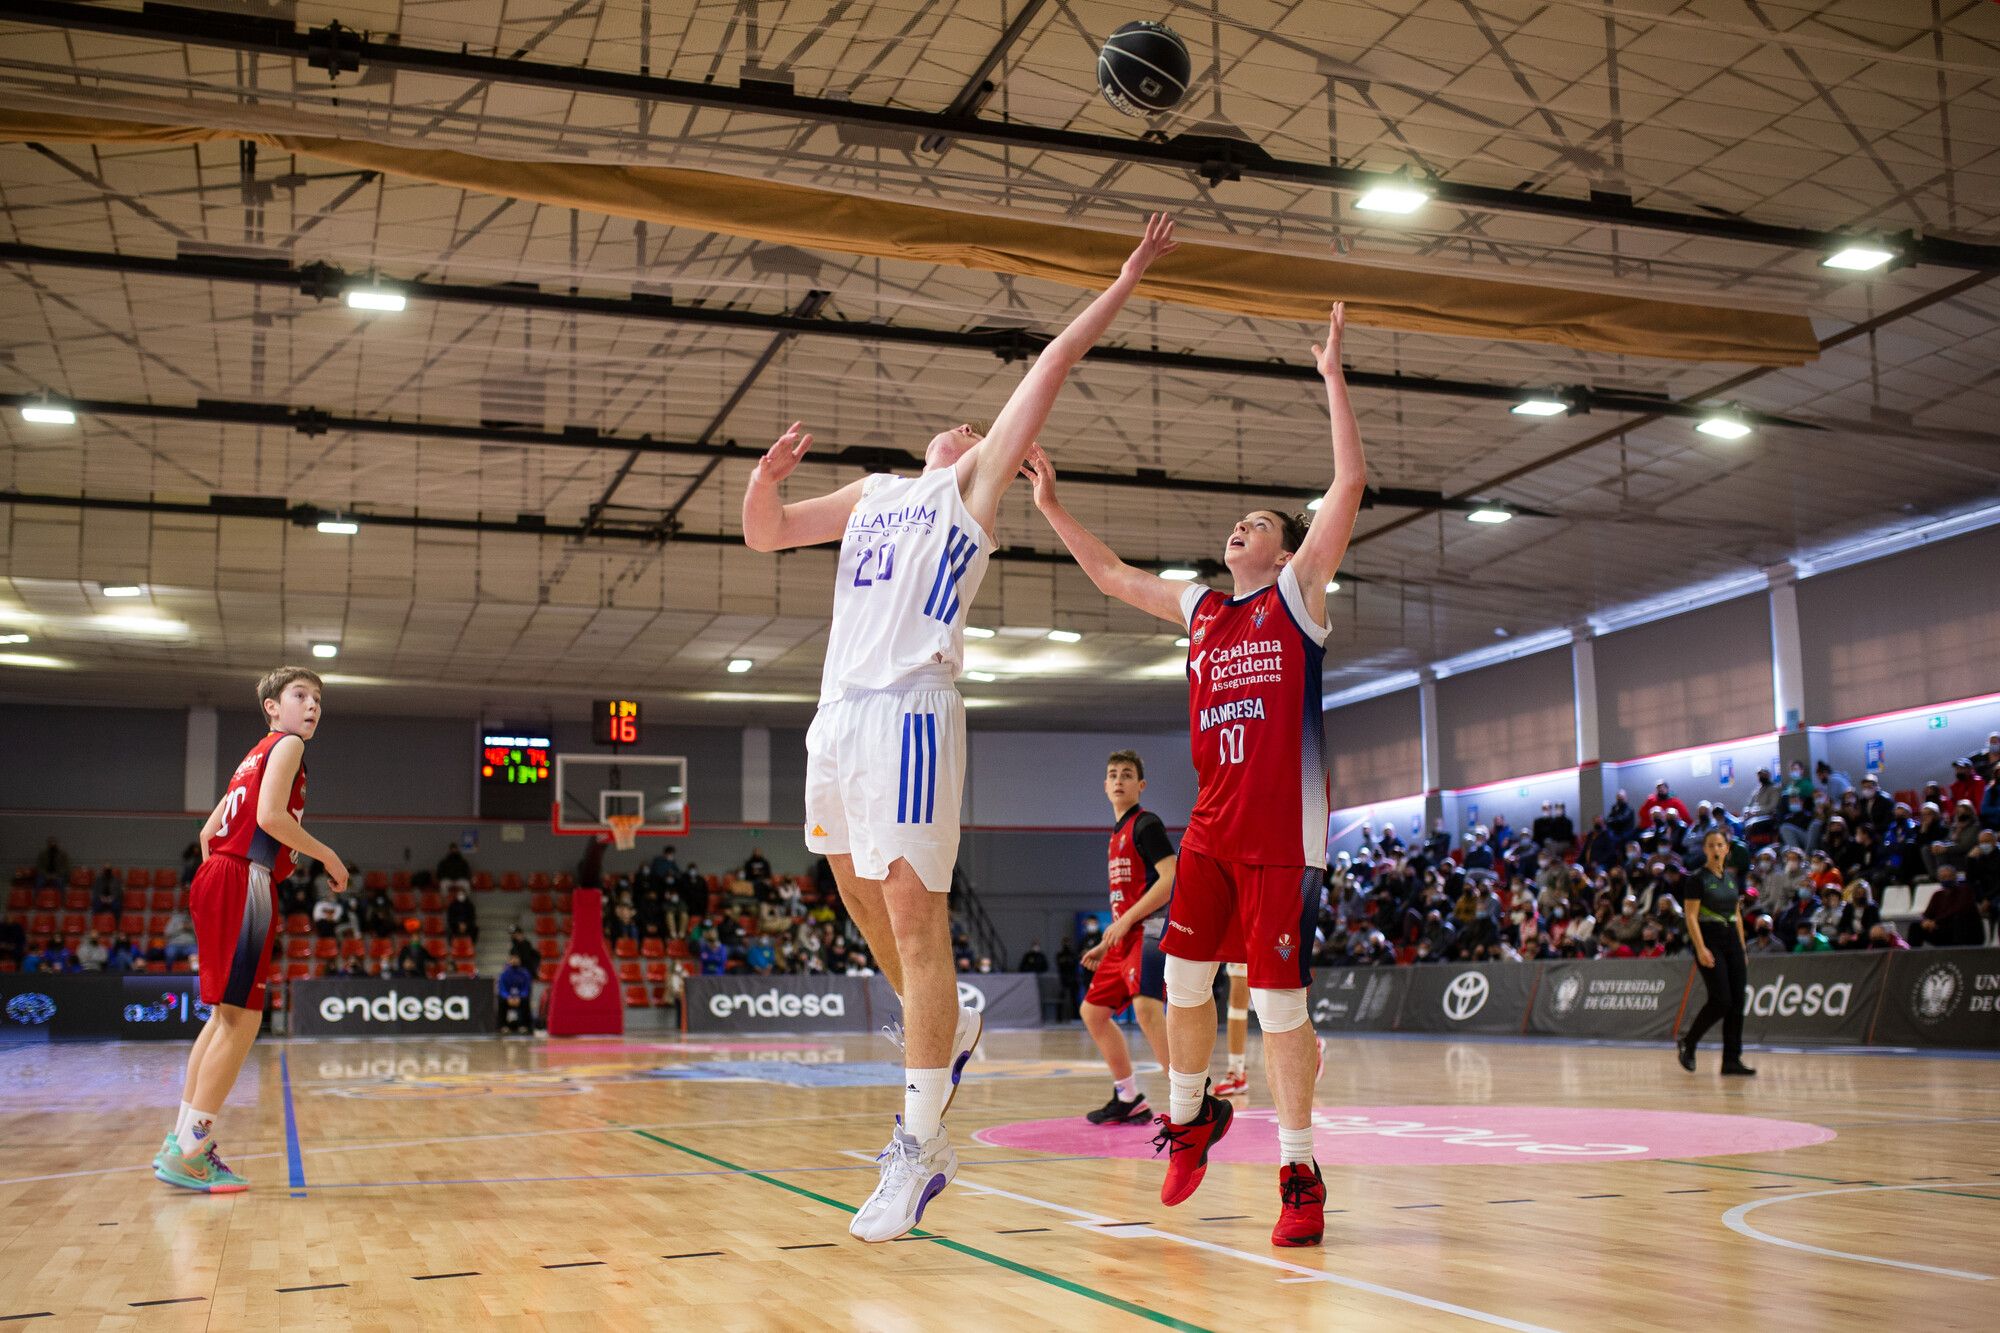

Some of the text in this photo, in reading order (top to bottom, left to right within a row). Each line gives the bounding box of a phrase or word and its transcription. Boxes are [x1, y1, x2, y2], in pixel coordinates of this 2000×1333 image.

[854, 543, 895, 587] 20
[1209, 639, 1283, 664] Catalana
[1211, 655, 1283, 681] Occident
[1211, 673, 1281, 692] Assegurances
[610, 716, 637, 742] 16
[1199, 697, 1266, 732] MANRESA
[319, 989, 470, 1022] endesa
[709, 988, 845, 1018] endesa
[1743, 974, 1853, 1017] ndesa
